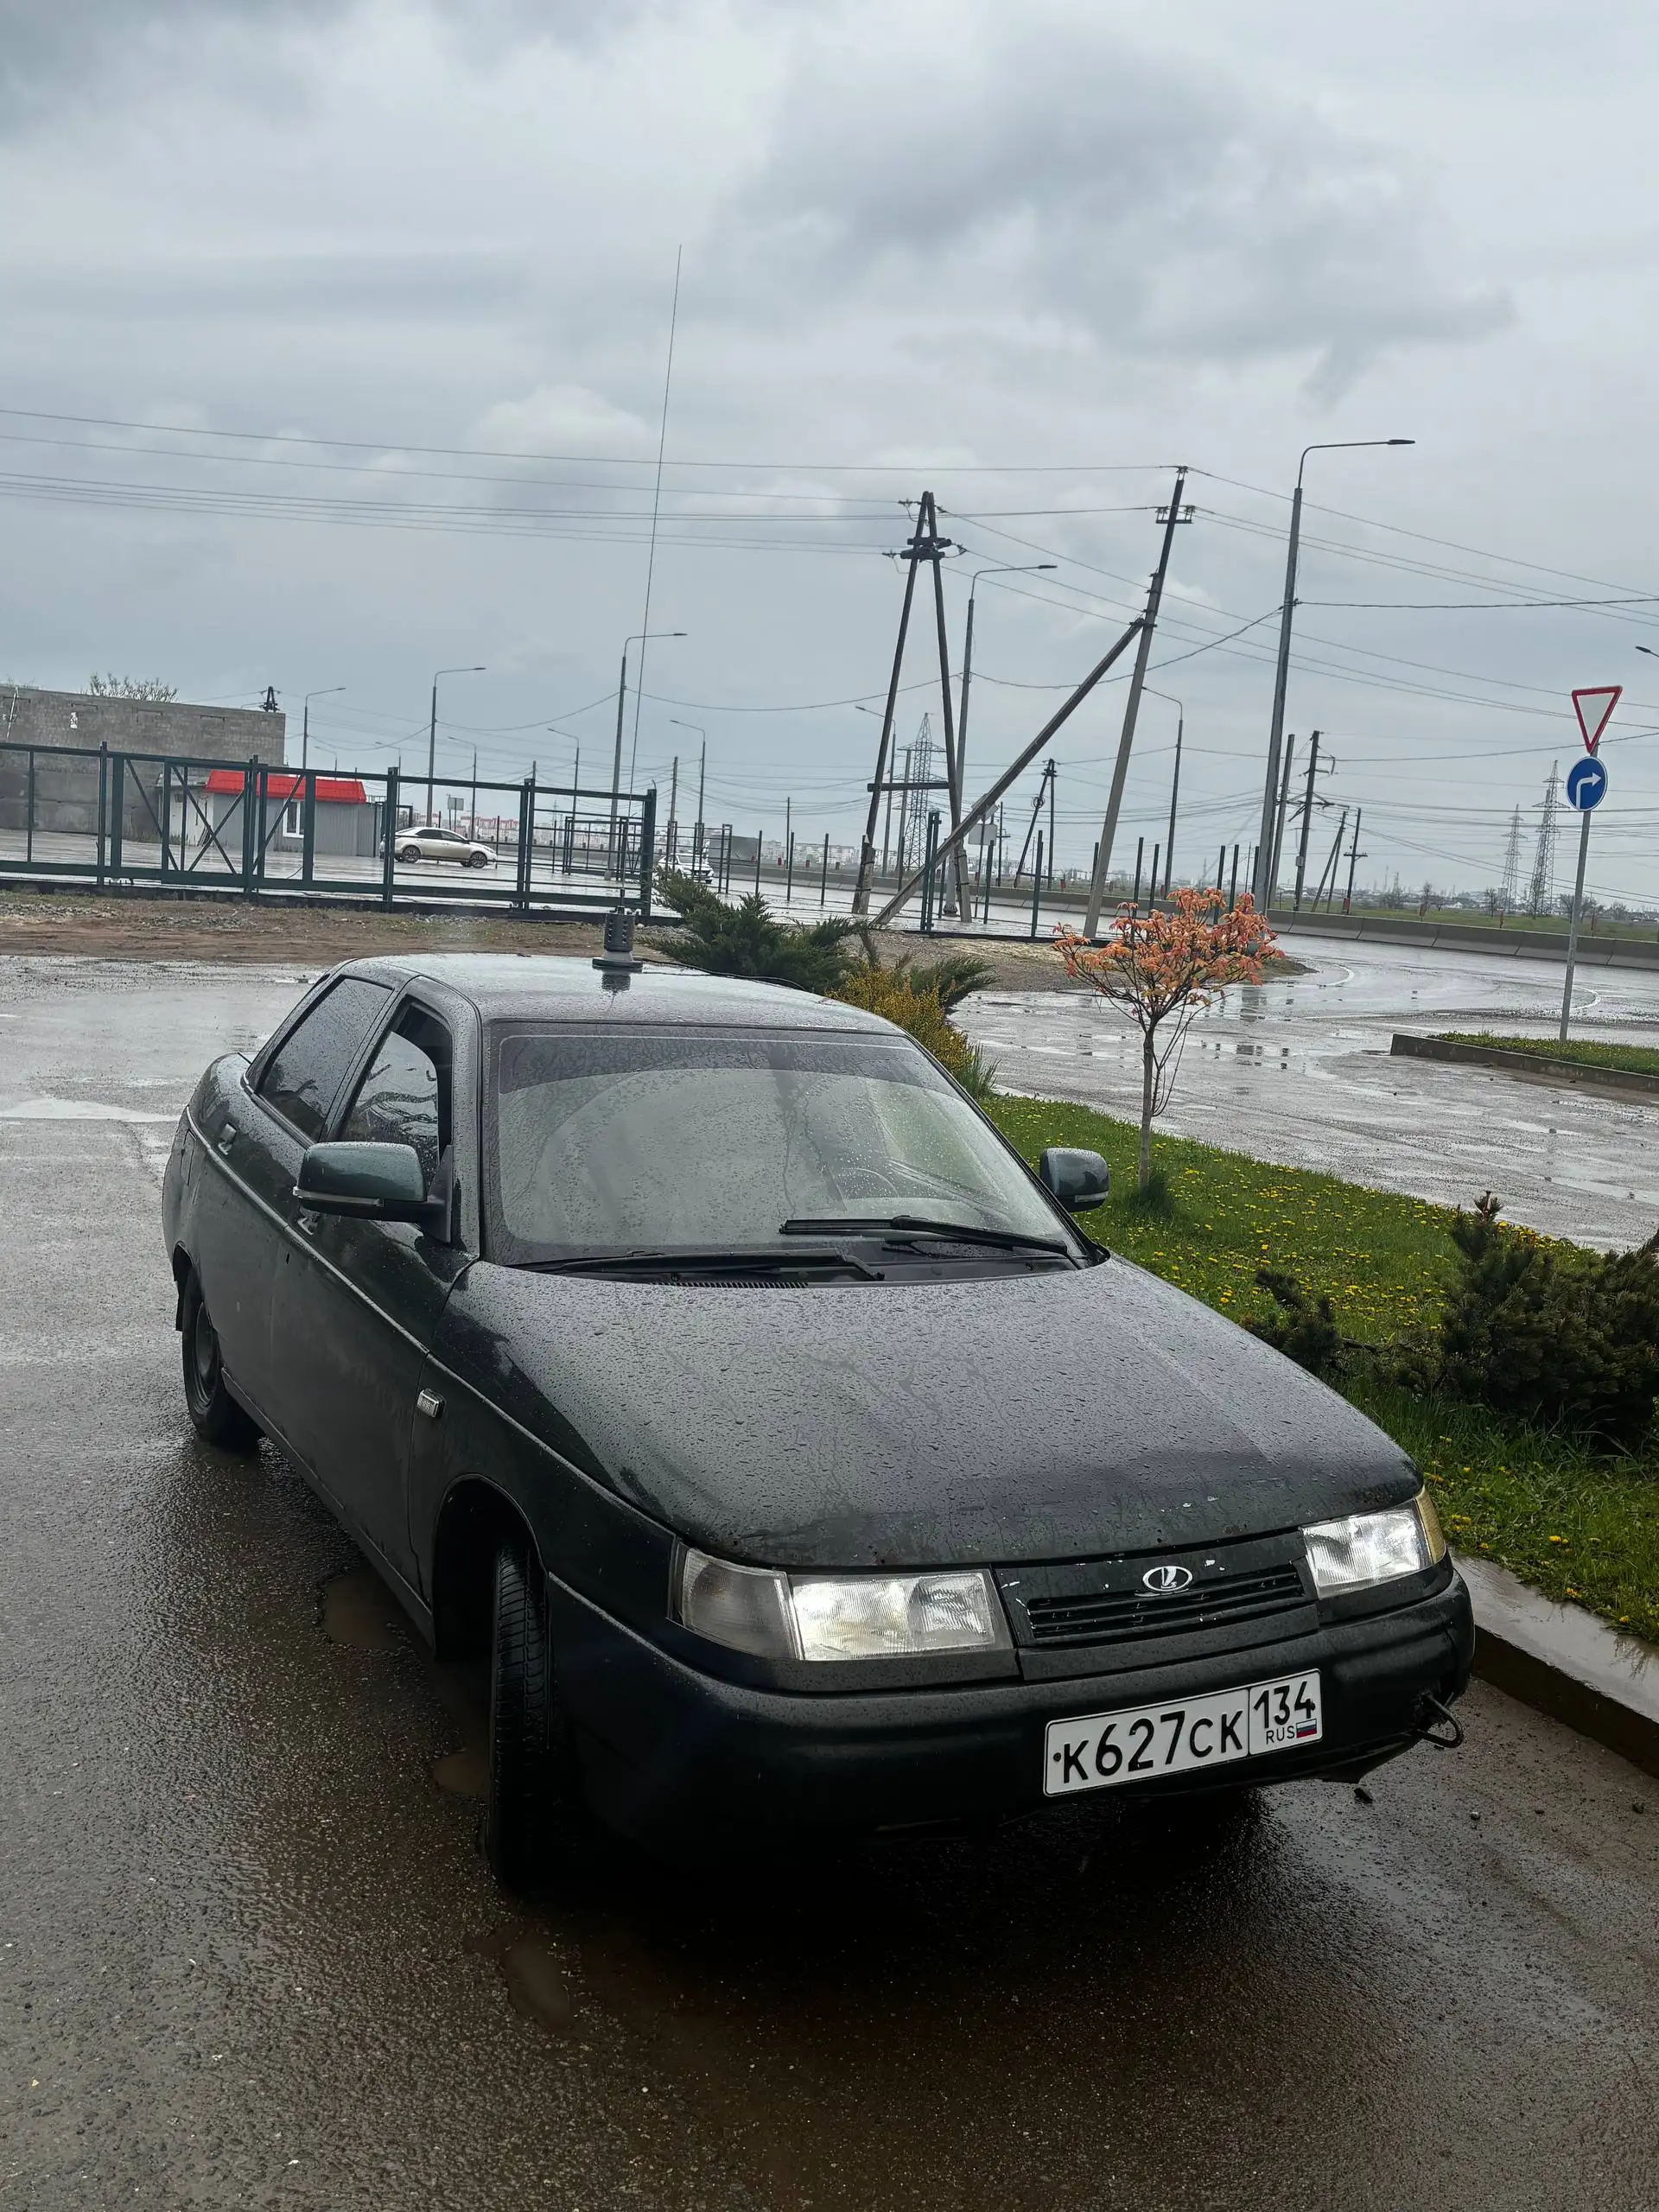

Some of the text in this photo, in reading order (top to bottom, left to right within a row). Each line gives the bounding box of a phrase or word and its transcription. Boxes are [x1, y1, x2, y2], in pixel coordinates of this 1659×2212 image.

[1063, 1681, 1316, 1783] К627СК 134
[1265, 1726, 1295, 1745] RUS
